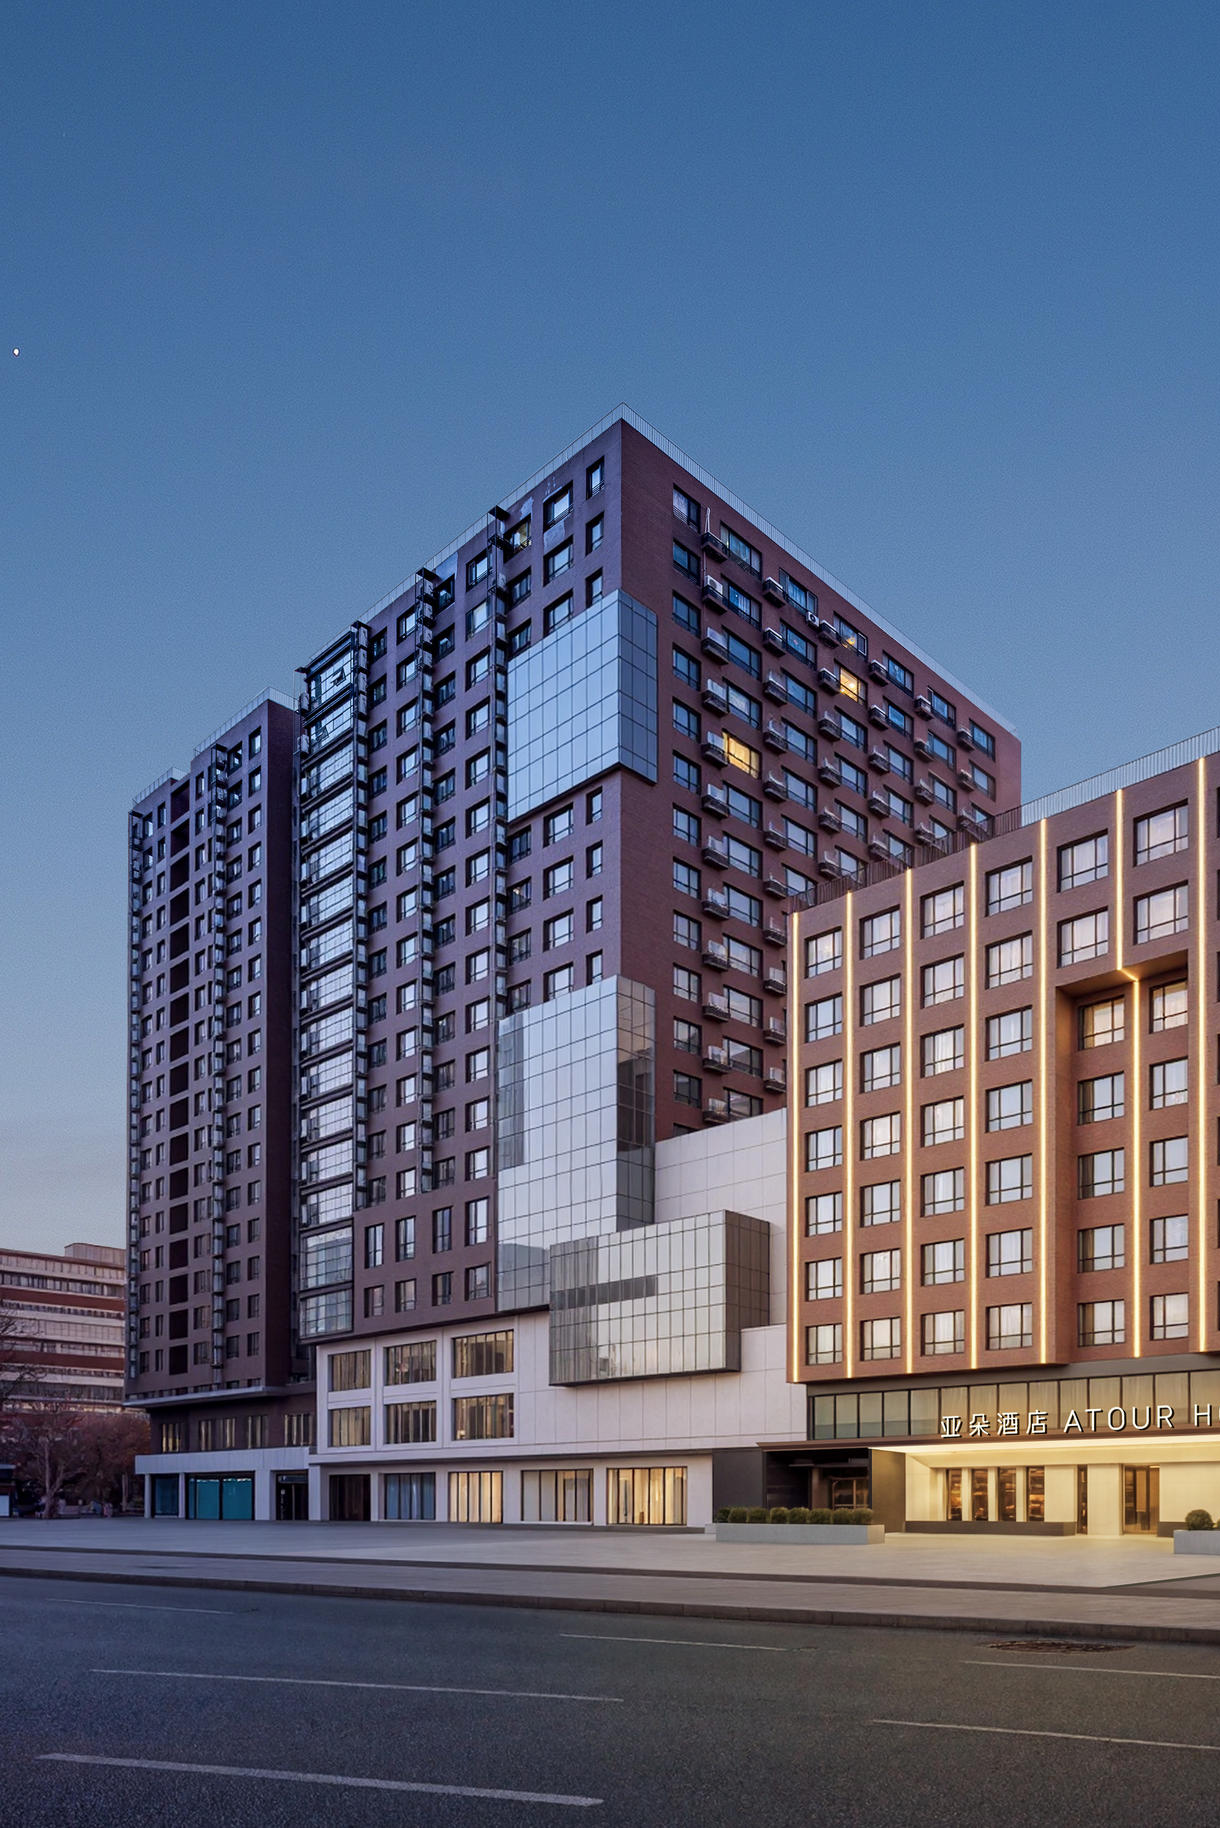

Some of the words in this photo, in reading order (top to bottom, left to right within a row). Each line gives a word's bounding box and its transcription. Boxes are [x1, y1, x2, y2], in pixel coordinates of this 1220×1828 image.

[940, 1409, 1049, 1438] 亚朵酒店
[1063, 1404, 1175, 1433] ATOUR
